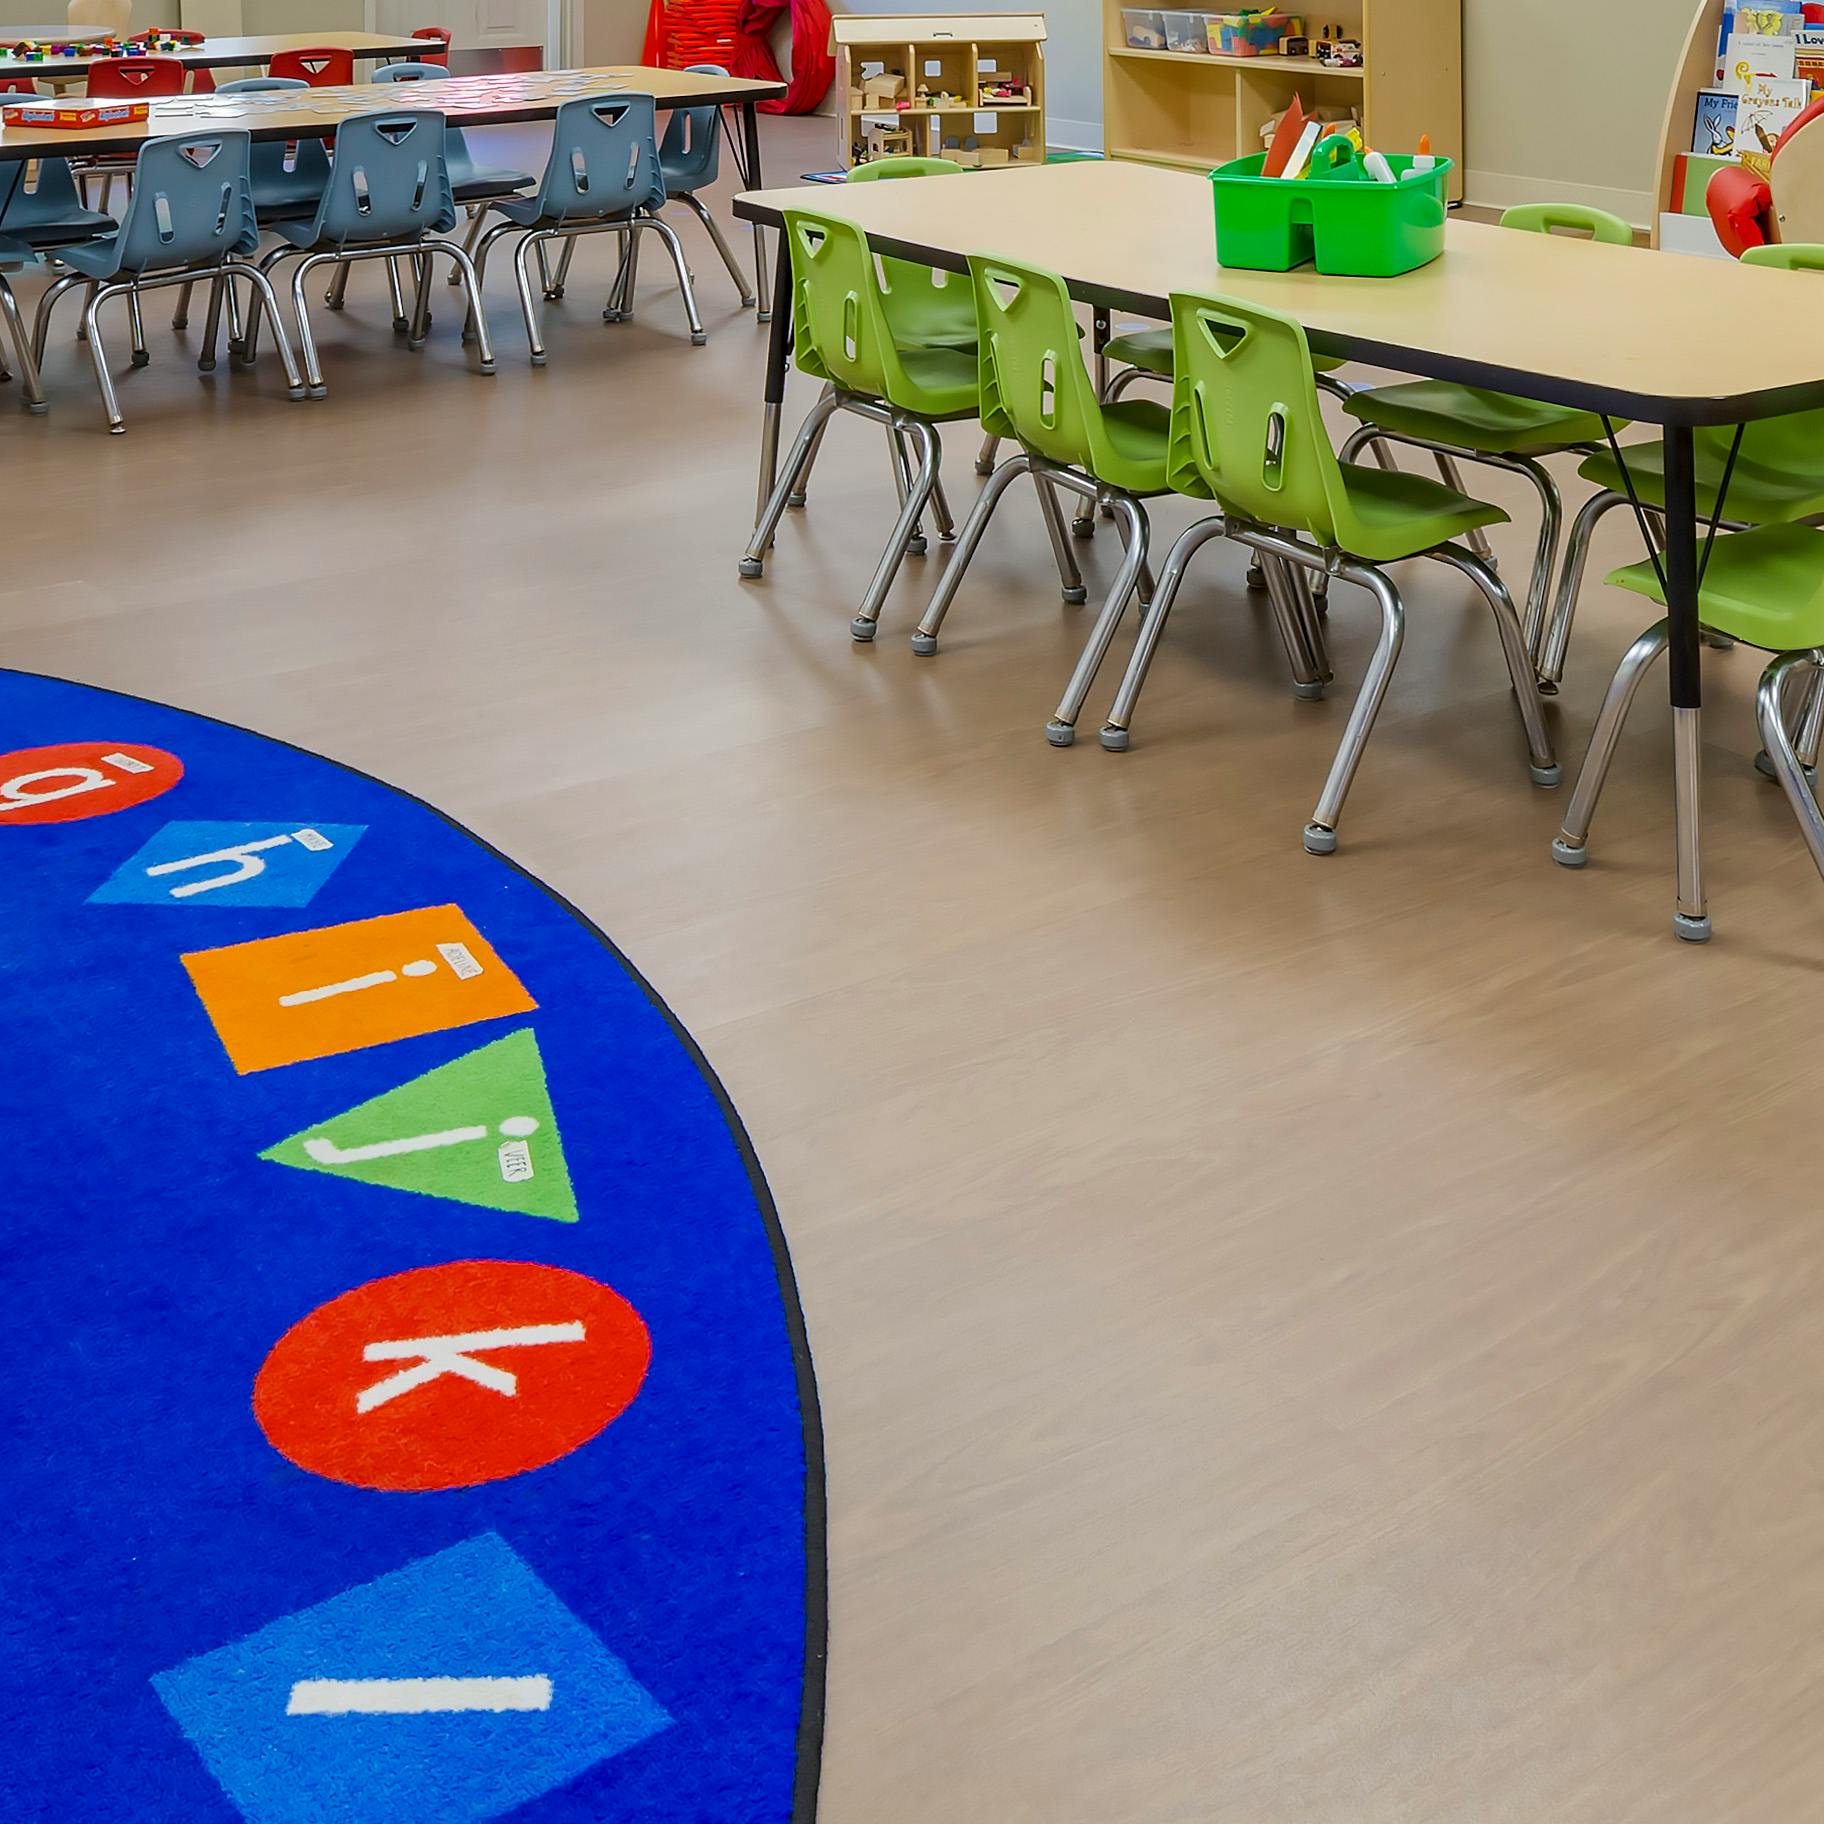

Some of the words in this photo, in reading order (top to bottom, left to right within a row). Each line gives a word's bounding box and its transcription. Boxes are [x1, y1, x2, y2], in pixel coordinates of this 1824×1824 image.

[1796, 34, 1801, 44] I
[1758, 83, 1773, 97] My
[1703, 97, 1719, 109] My
[1782, 98, 1802, 109] Talk
[146, 833, 294, 898] h
[278, 959, 438, 1007] i
[302, 1115, 540, 1164] j
